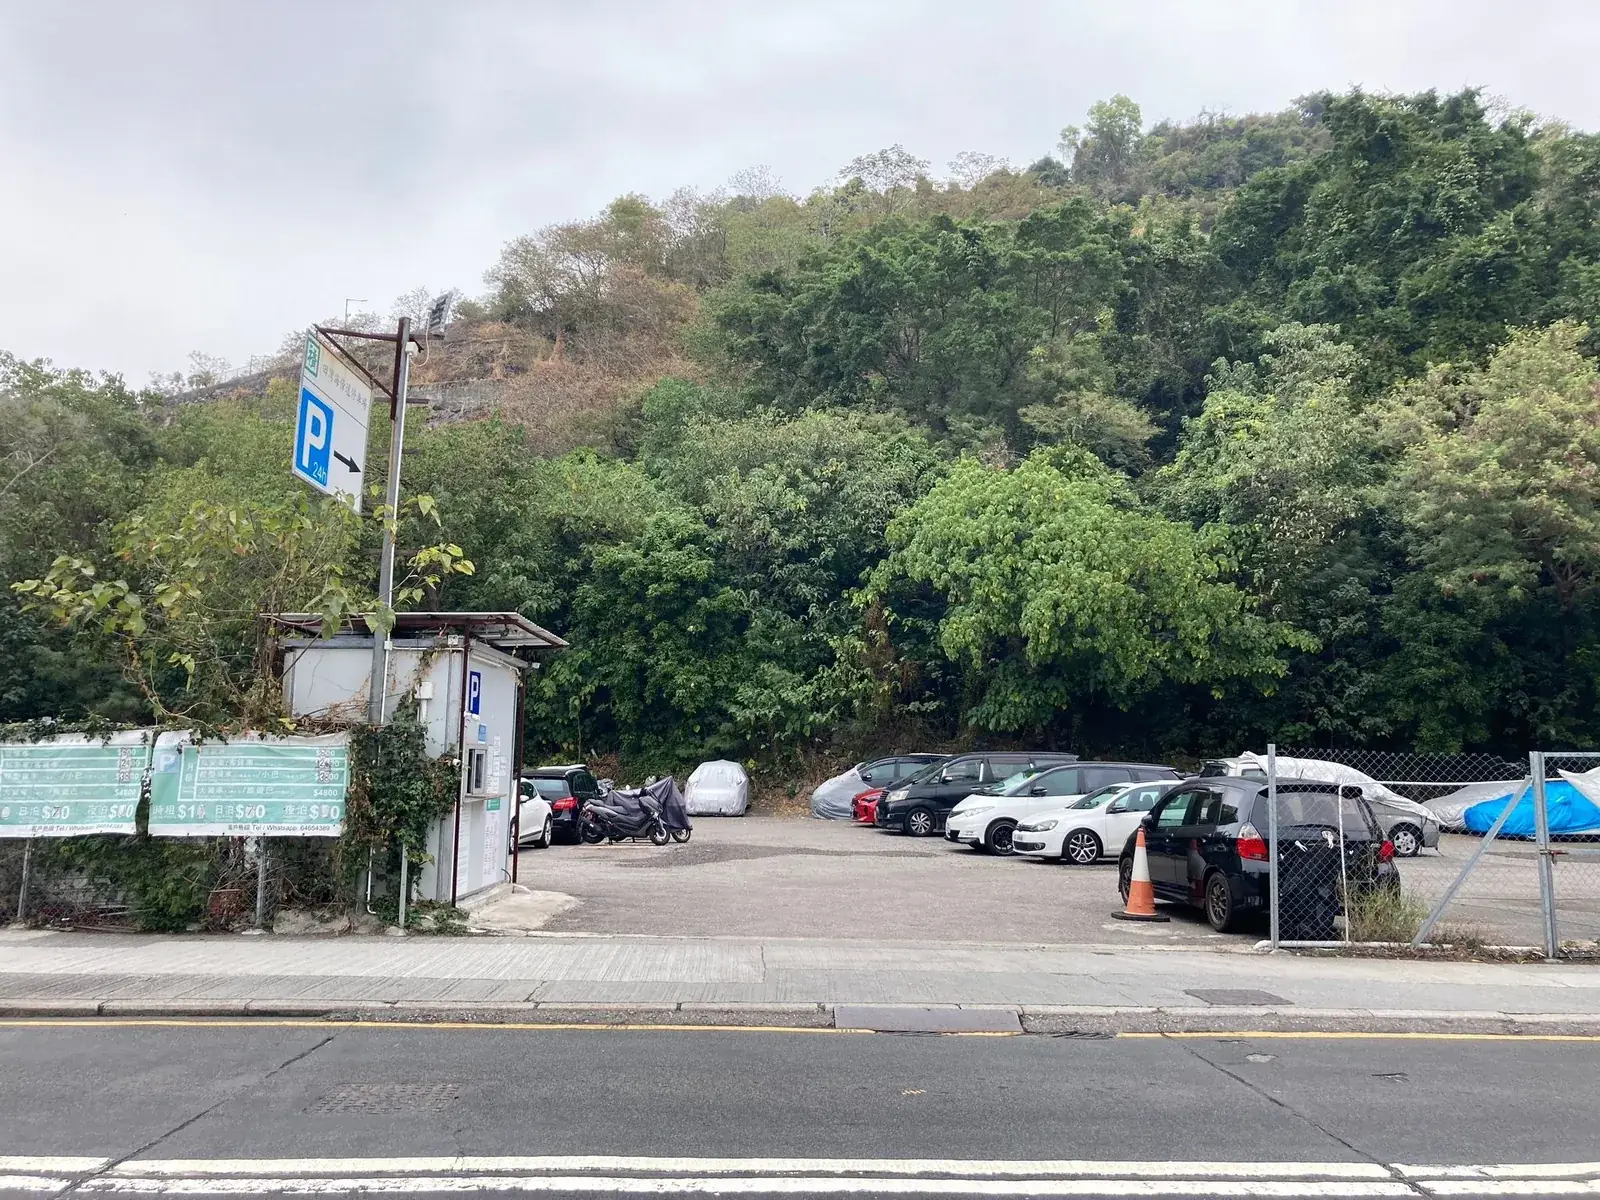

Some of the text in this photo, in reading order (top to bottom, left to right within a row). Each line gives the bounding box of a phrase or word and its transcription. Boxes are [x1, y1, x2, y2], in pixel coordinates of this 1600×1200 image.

[302, 399, 328, 469] P
[312, 461, 327, 485] 24h
[470, 675, 479, 711] P
[160, 754, 175, 772] P
[313, 789, 338, 798] $4800
